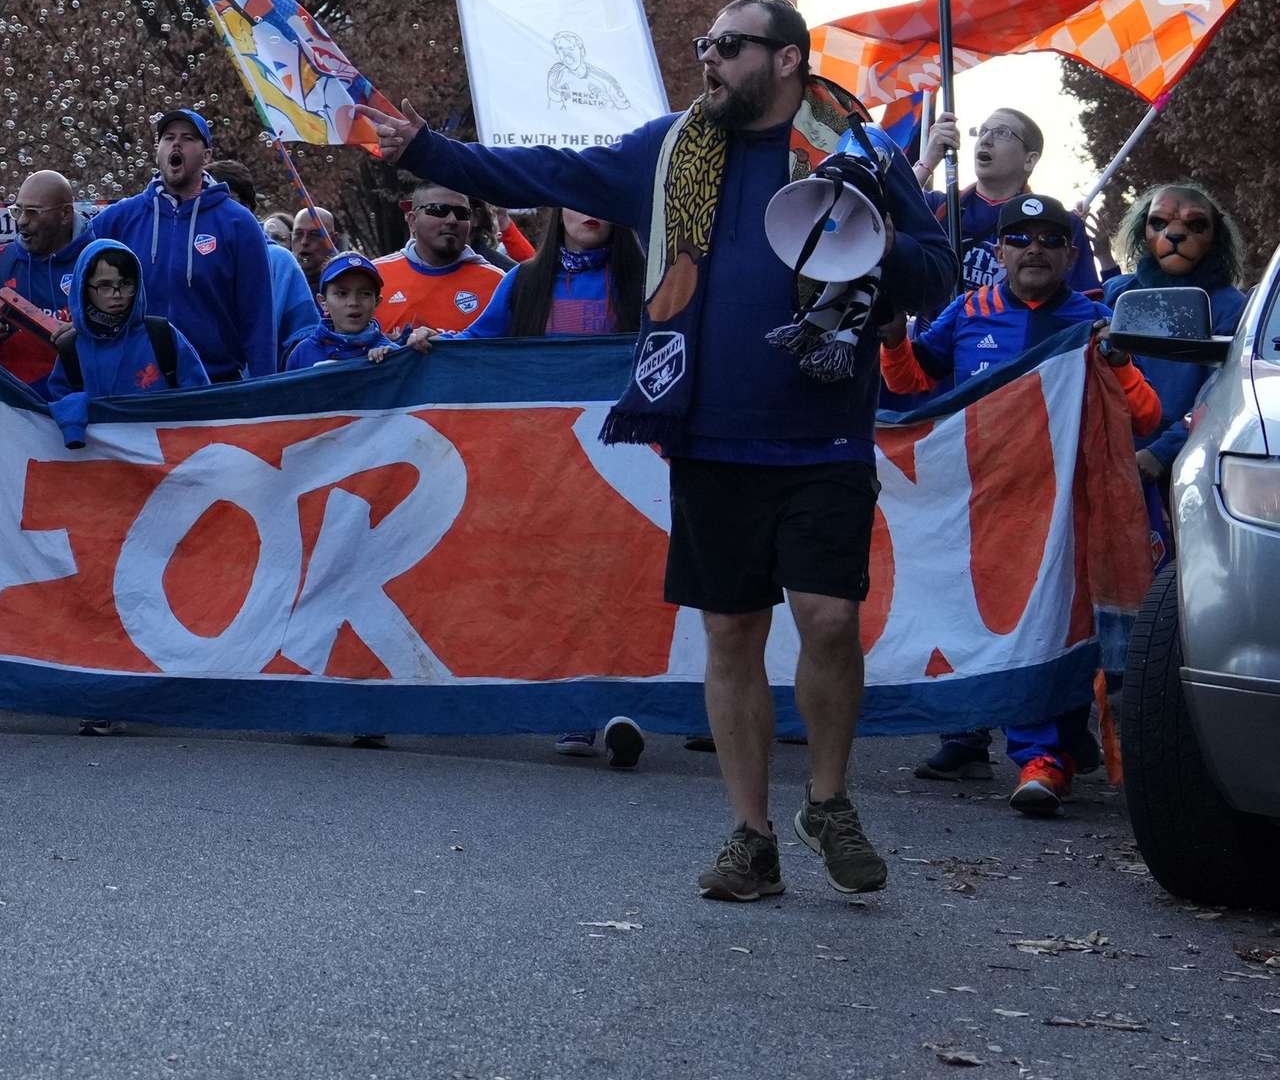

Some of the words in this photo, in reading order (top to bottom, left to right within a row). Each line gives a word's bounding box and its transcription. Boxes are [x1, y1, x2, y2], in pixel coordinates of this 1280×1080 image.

[492, 133, 517, 146] DIE
[521, 133, 557, 146] WITH
[561, 133, 590, 146] THE
[639, 334, 684, 375] CINCINNATI
